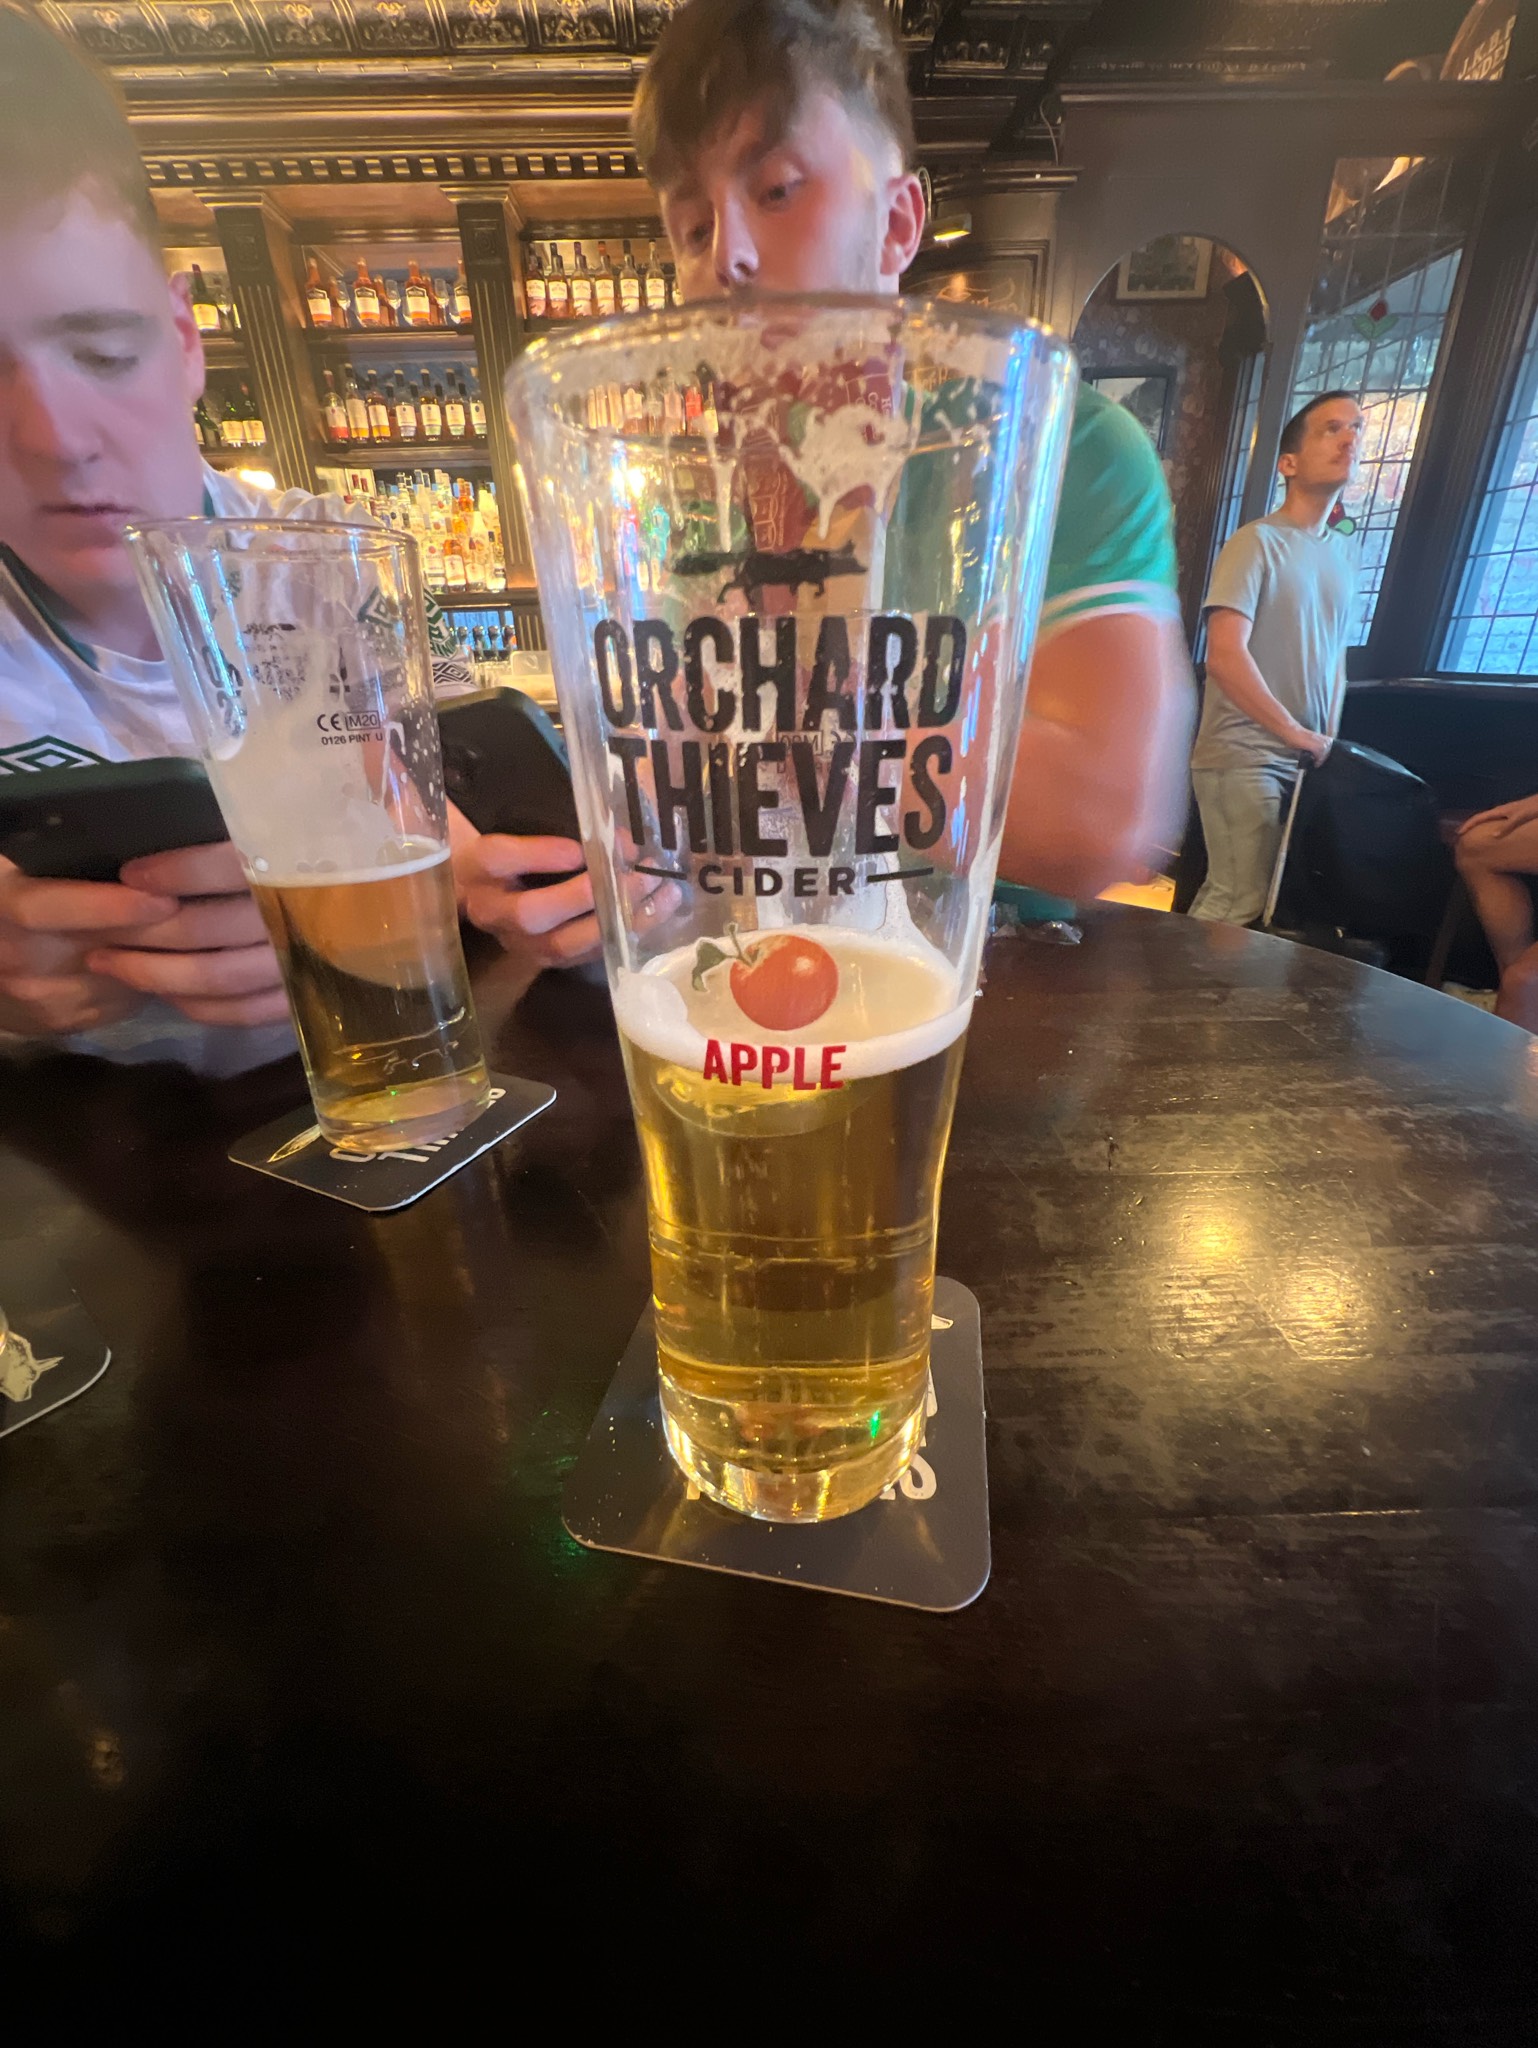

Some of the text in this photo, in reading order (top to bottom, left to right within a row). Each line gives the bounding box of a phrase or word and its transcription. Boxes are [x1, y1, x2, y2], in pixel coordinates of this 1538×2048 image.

[594, 615, 968, 733] ORCHARD
[321, 735, 347, 746] 0126
[348, 733, 371, 743] PINT
[348, 713, 378, 728] M20
[607, 734, 953, 858] THIEVES
[699, 864, 856, 897] CIDER
[702, 1039, 847, 1091] APPLE
